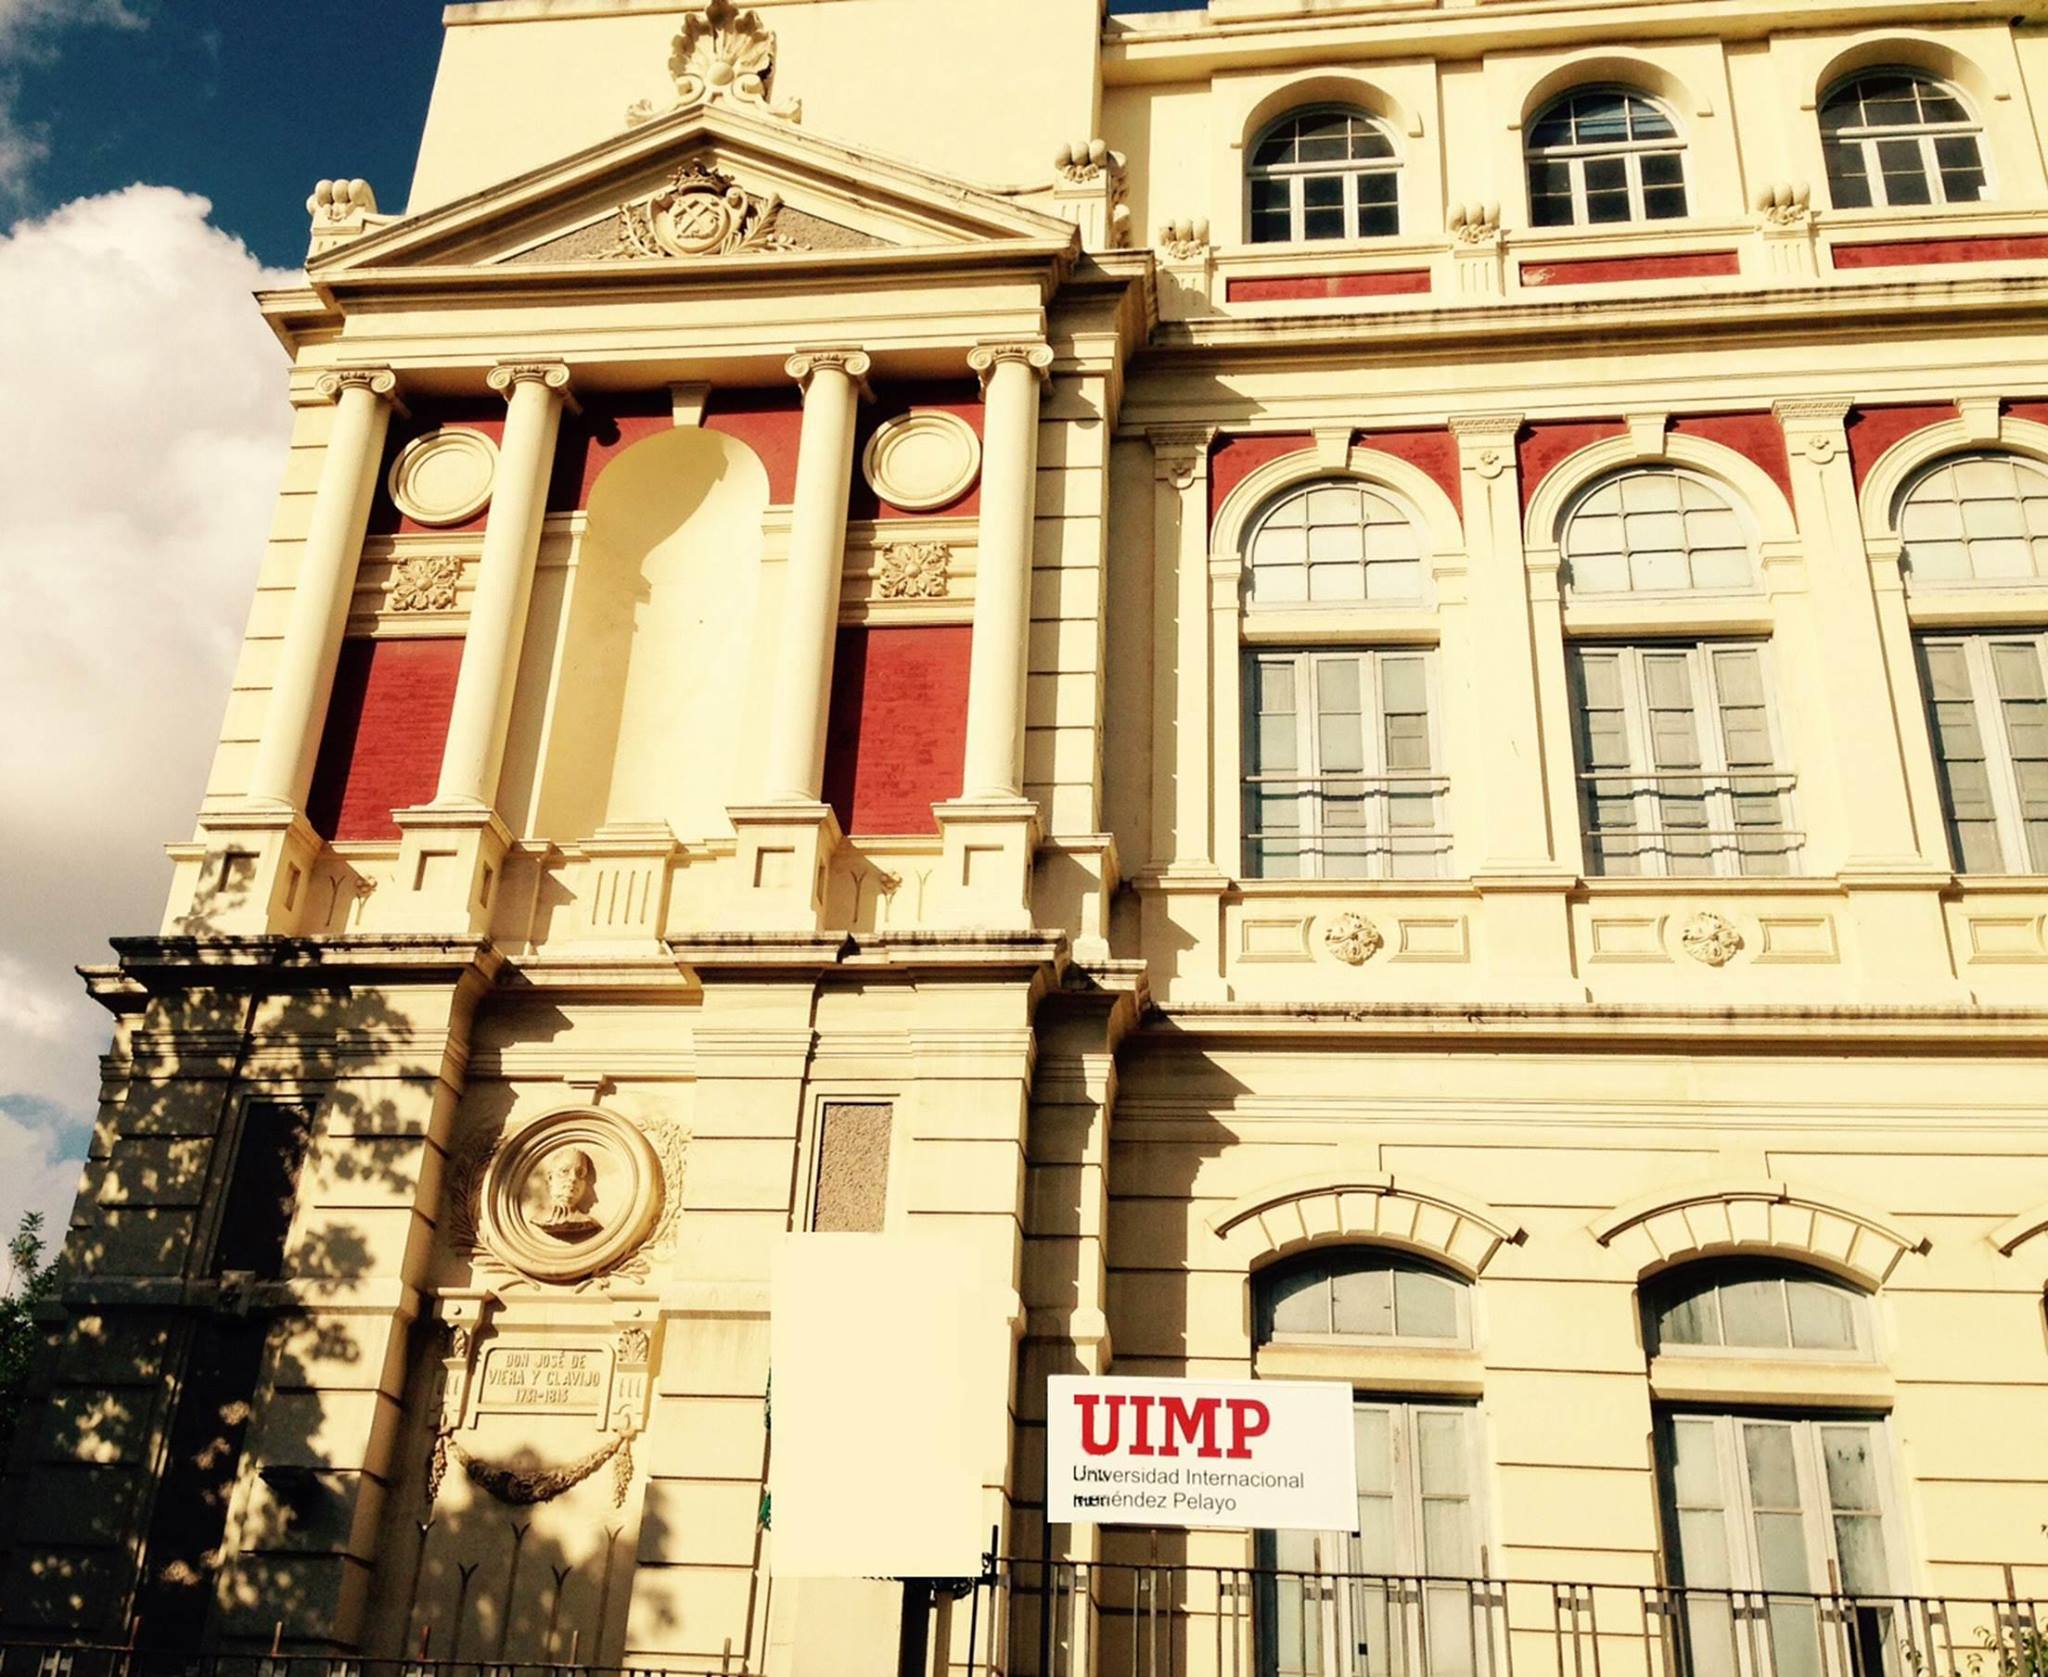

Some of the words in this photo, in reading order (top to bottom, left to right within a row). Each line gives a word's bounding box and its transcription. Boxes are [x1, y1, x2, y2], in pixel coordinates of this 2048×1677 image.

[507, 1354, 531, 1369] DON
[536, 1350, 566, 1370] JOSÉ
[571, 1354, 587, 1370] DE
[489, 1370, 525, 1386] VIERA
[531, 1370, 542, 1386] Y
[547, 1370, 601, 1387] CLAVIJO
[1073, 1394, 1271, 1459] UIMP
[1073, 1465, 1180, 1485] Universidad
[1186, 1468, 1305, 1488] Internacional
[1173, 1492, 1237, 1515] Pelayo
